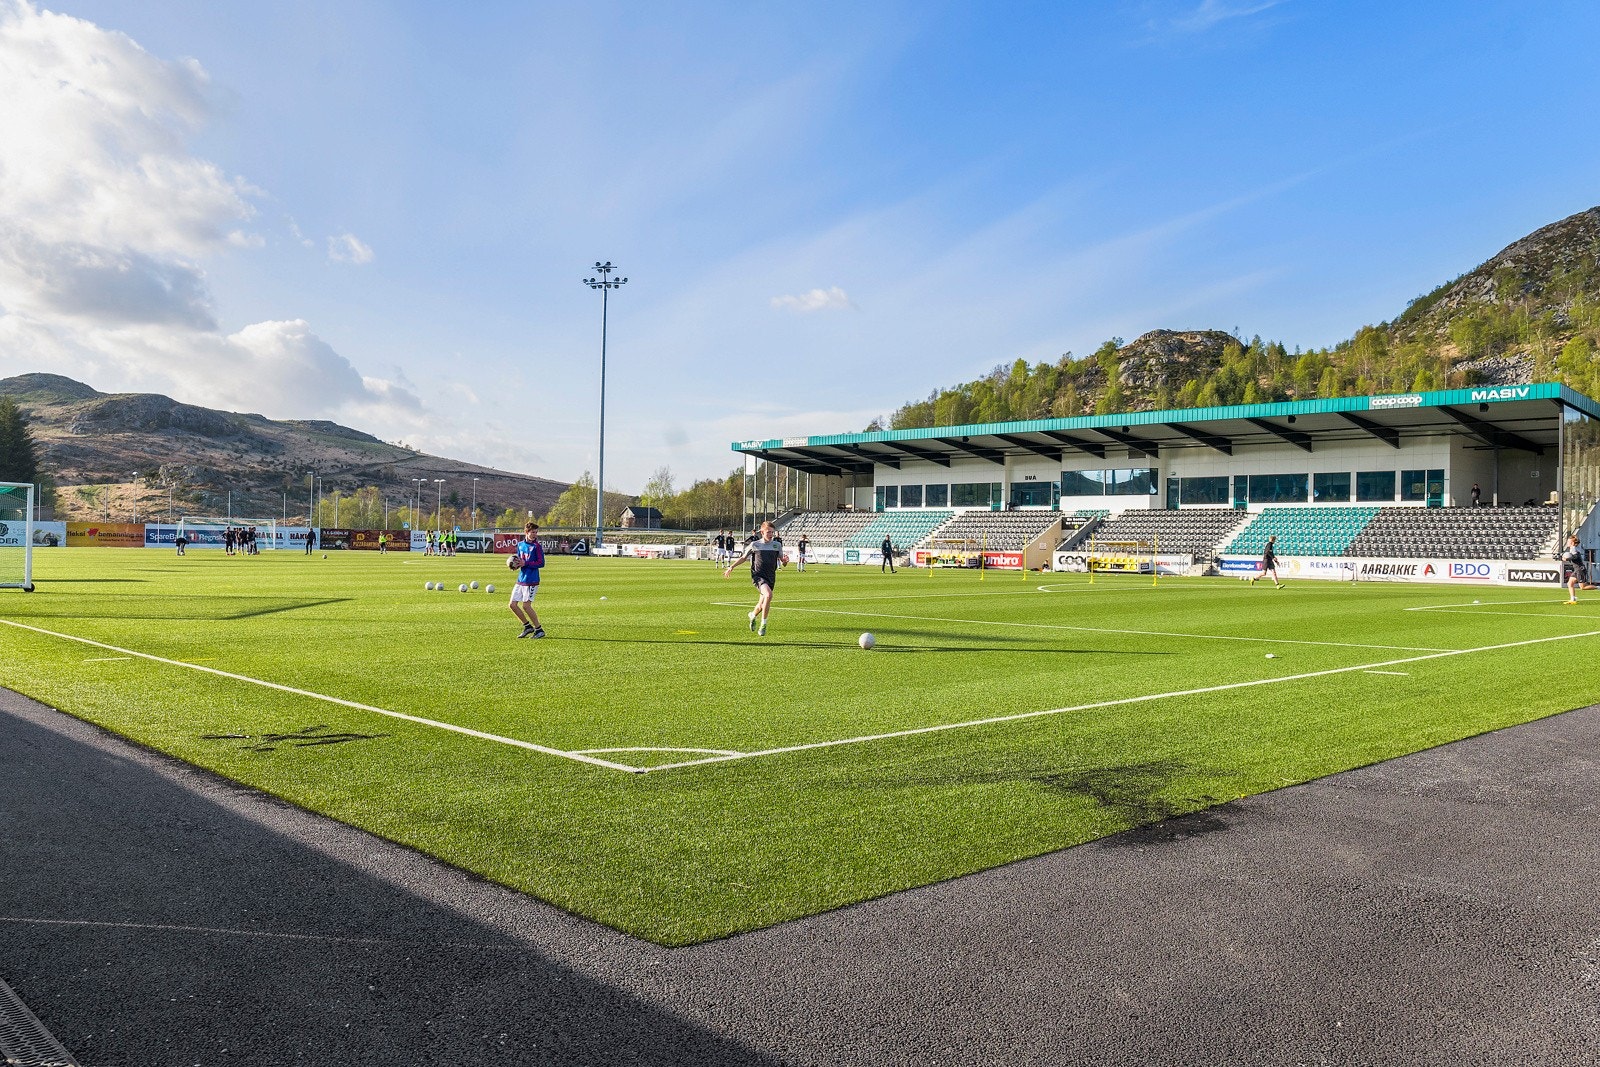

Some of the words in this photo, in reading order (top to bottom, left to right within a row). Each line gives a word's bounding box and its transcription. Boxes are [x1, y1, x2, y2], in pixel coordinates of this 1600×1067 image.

[1471, 387, 1530, 401] MASIV
[456, 540, 489, 550] ASIV
[984, 554, 1020, 565] umbro
[1361, 563, 1418, 576] AARBAKKE
[1454, 563, 1491, 576] BDO
[1510, 571, 1557, 581] MASIV
